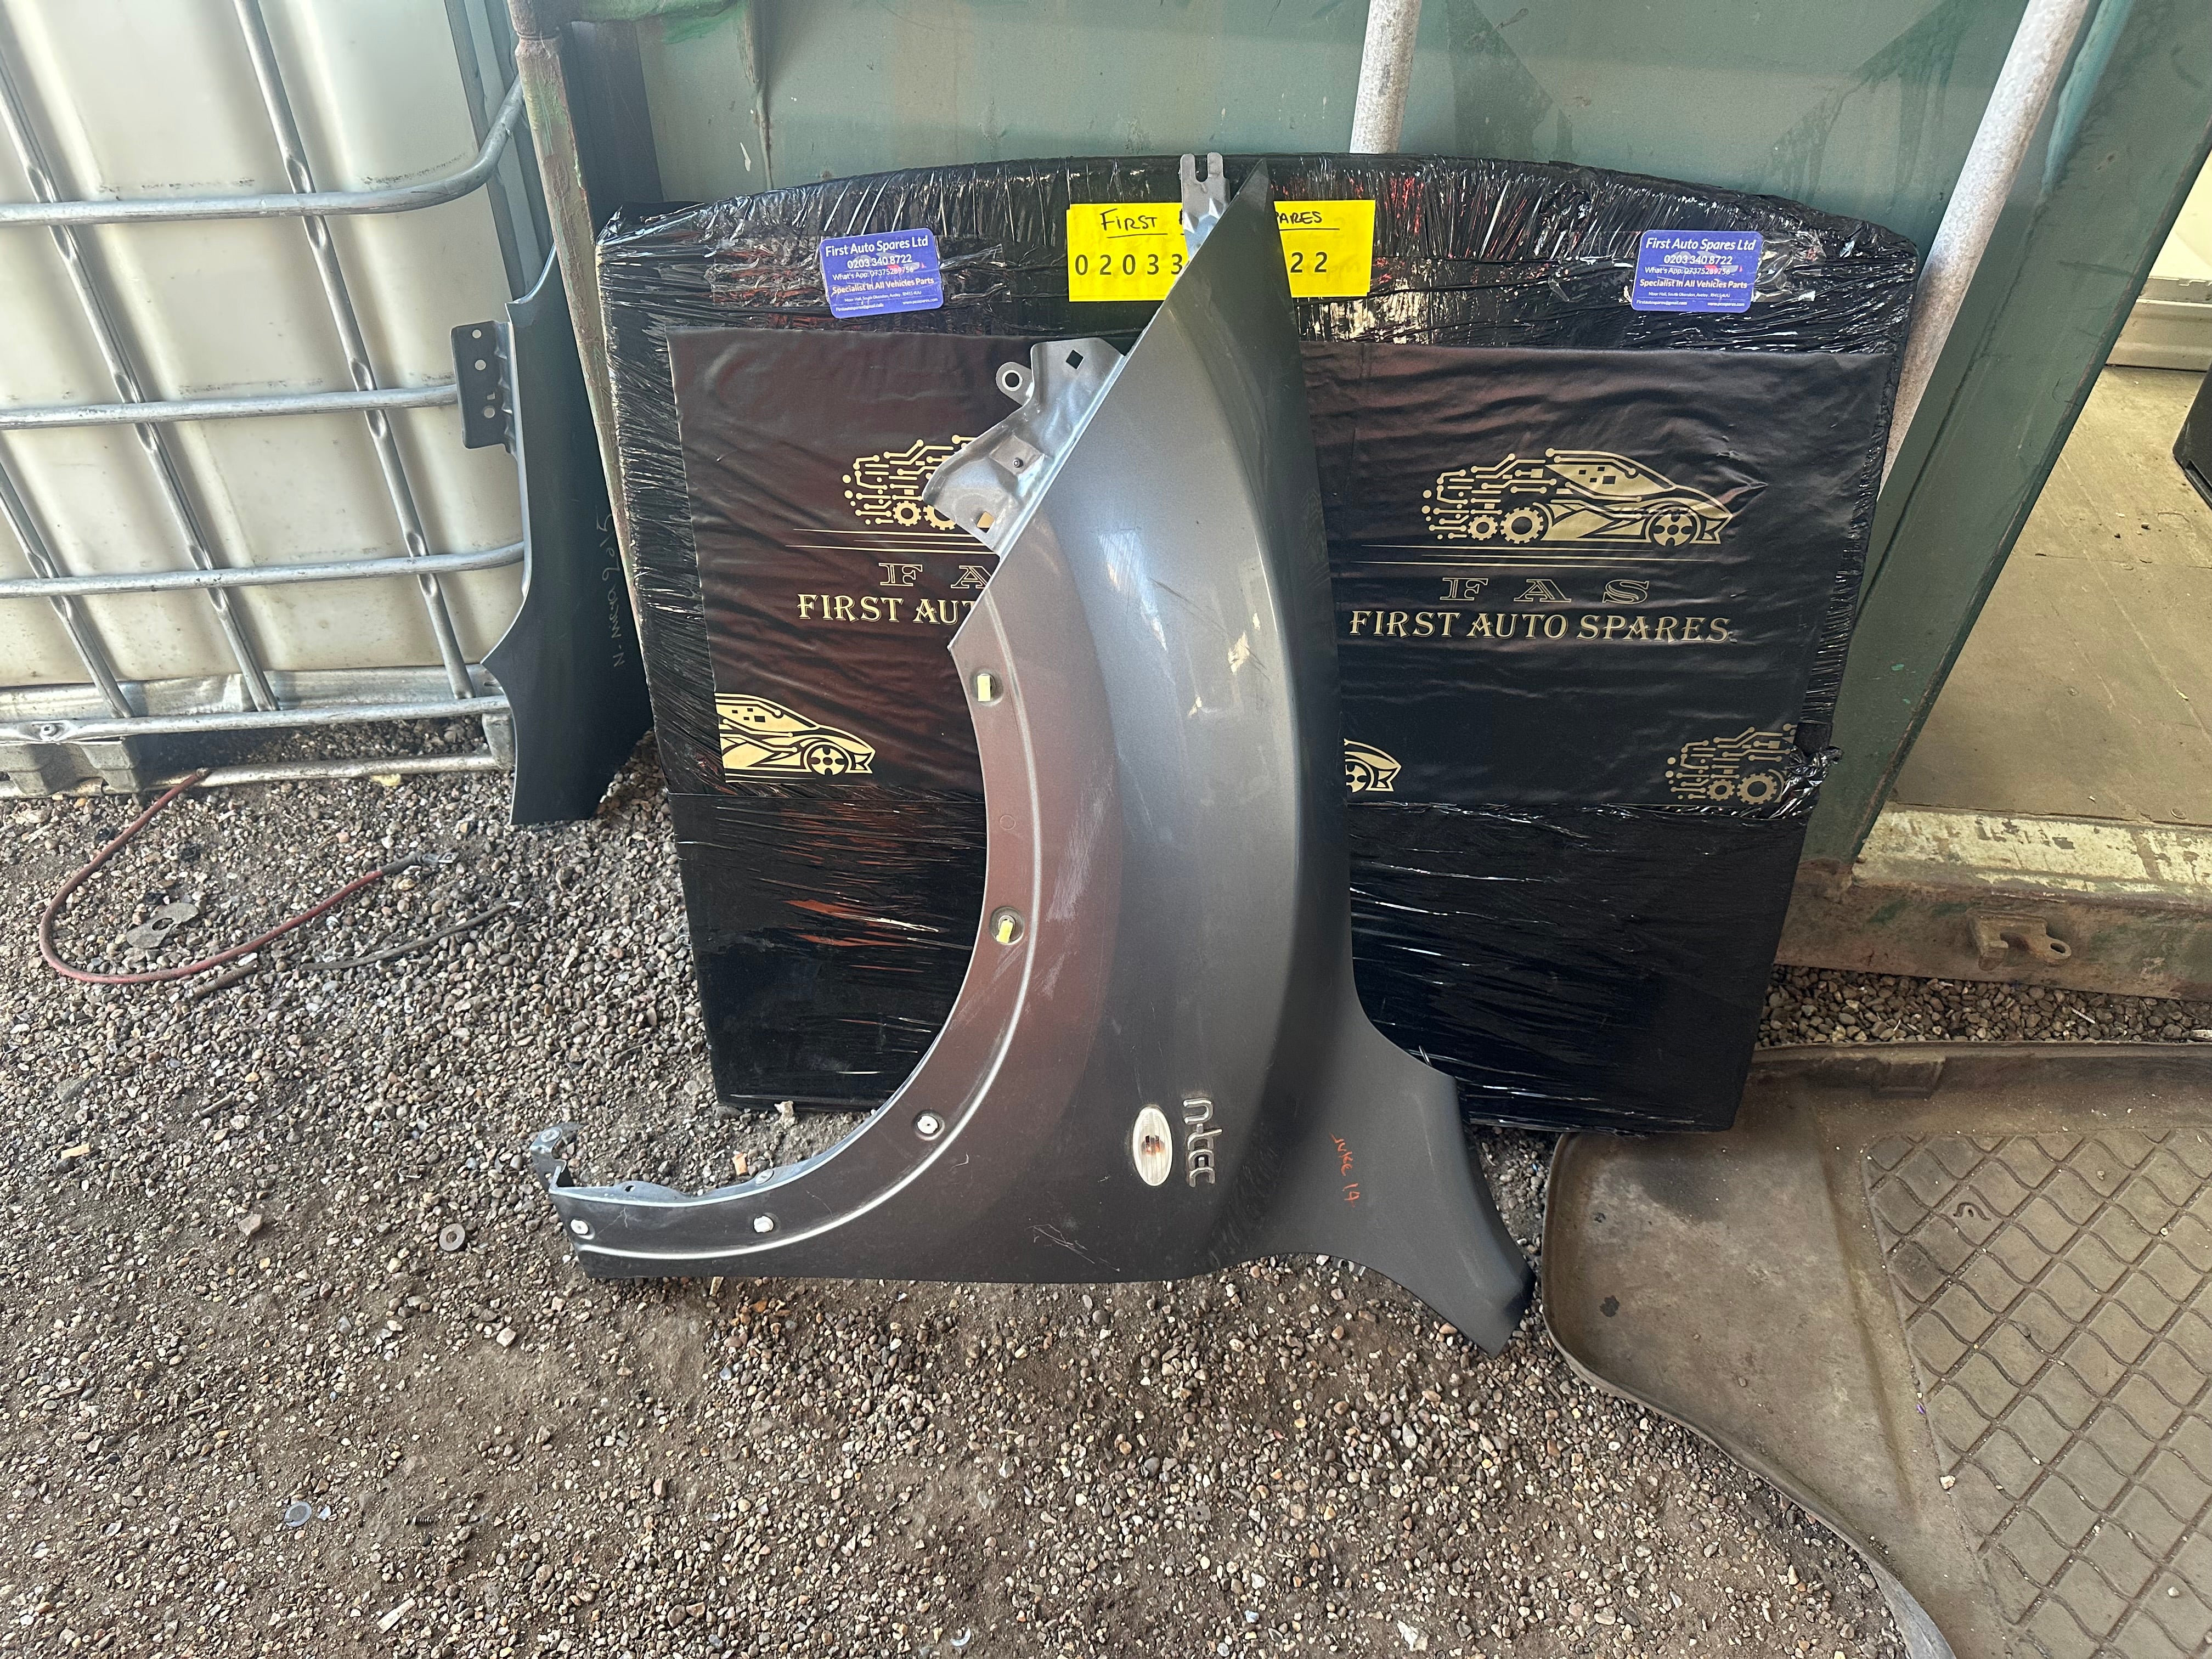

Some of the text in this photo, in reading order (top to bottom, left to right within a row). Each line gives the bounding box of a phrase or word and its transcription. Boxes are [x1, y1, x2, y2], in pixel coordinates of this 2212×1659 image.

[1276, 211, 1322, 224] ARES
[825, 235, 929, 257] First Auto Spares Ltd
[1645, 237, 1757, 252] First Auto Spares Ltd
[847, 254, 912, 269] 0203 340 8722
[1663, 255, 1733, 265] 0203 340 8722
[832, 272, 855, 281] What's
[870, 266, 914, 277] 07375289756
[1684, 267, 1731, 275] 07375289756
[832, 284, 867, 295] Specialist
[874, 281, 885, 290] All
[885, 279, 915, 289] Vehicles
[915, 276, 935, 285] Parts
[1639, 279, 1675, 287] Specialist
[1696, 280, 1727, 288] Vehicles
[1728, 280, 1748, 289] Parts
[797, 594, 976, 625] FIRST AU
[1349, 610, 1731, 645] FIRST AUTO SPARES
[1182, 1097, 1223, 1188] n-tec
